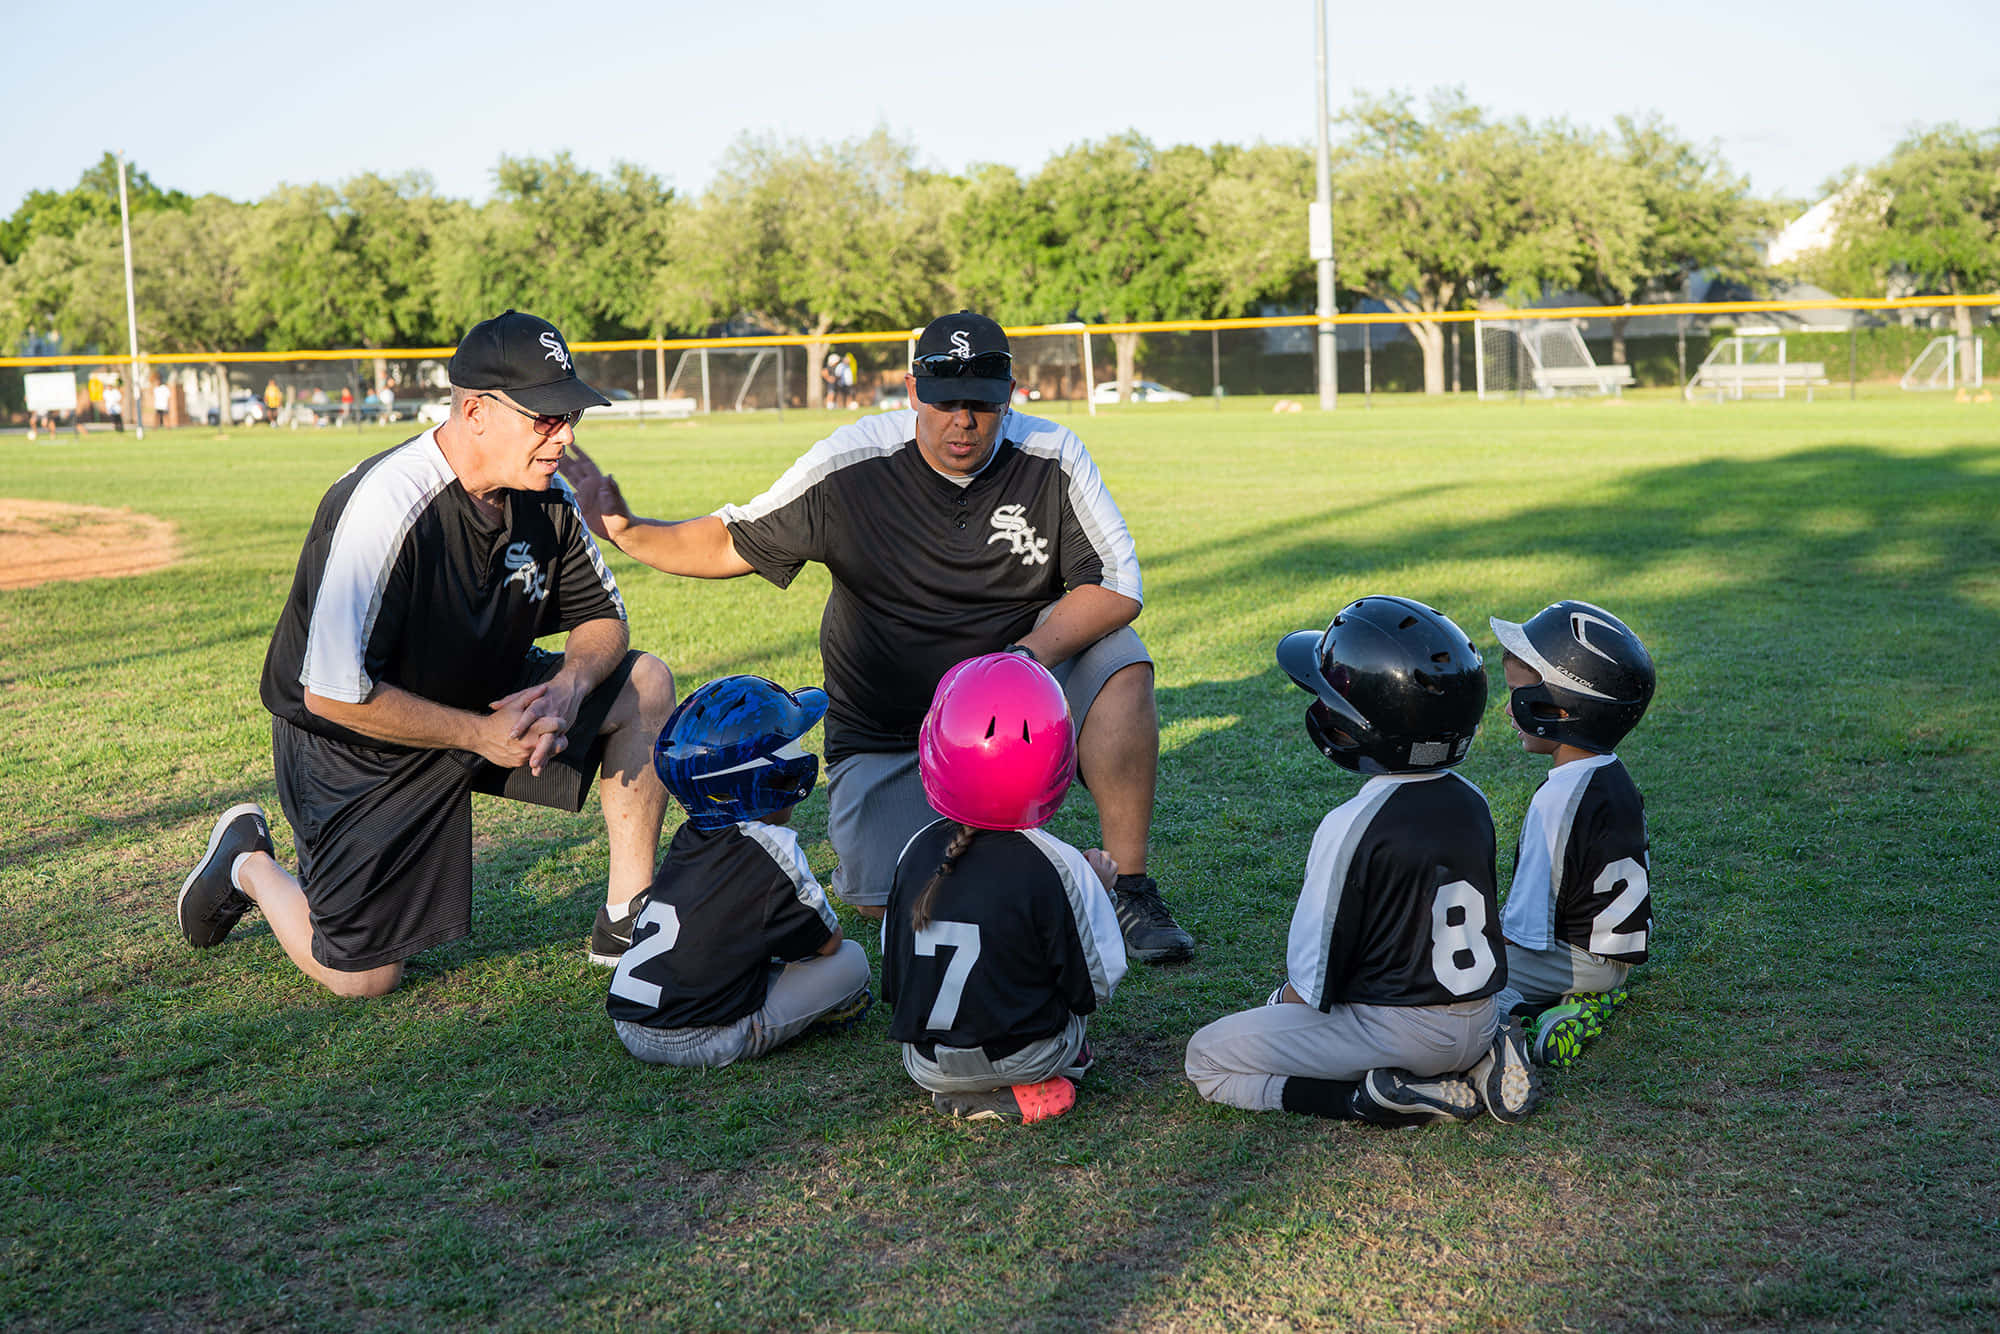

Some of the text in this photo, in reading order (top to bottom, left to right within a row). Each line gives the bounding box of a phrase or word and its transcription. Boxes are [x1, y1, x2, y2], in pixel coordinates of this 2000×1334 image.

[1555, 664, 1595, 688] EASTON
[609, 900, 681, 1009] 2
[1431, 880, 1497, 997] 8
[1589, 857, 1649, 955] 2
[914, 920, 981, 1031] 7
